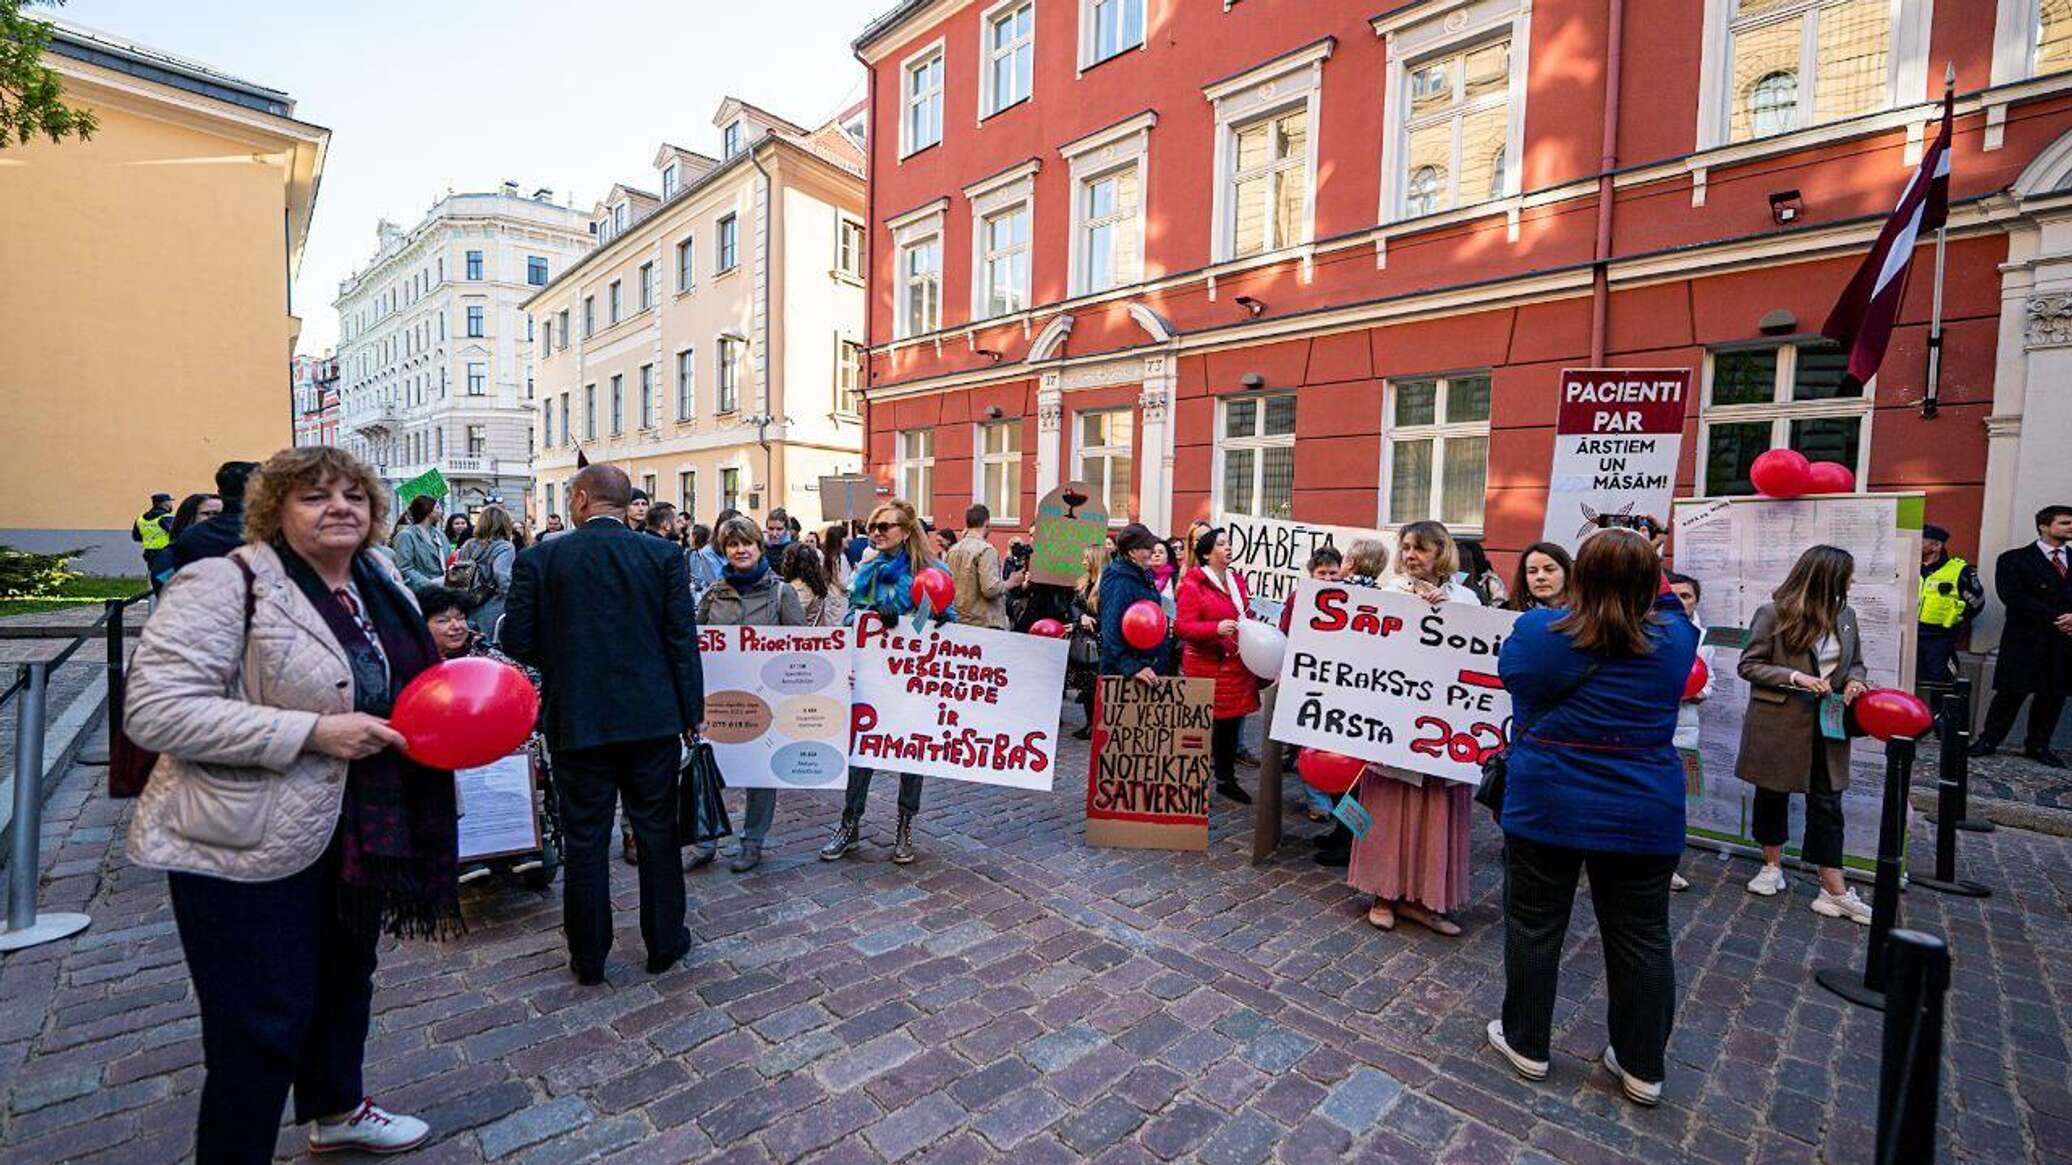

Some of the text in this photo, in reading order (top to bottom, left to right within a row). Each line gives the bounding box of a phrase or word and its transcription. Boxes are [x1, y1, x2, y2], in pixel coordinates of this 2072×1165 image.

[1566, 381, 1682, 403] PACIENTI
[1593, 410, 1643, 432] PAR
[1575, 436, 1655, 454] ĀRSTIEM
[1599, 458, 1626, 472] UN
[1592, 472, 1668, 490] MĀSĀM!
[907, 676, 998, 705] APRŪPE
[1104, 704, 1125, 727] UZ
[1297, 691, 1513, 768] ĀRSTA 202
[1099, 753, 1211, 785] NOTEIKTAS
